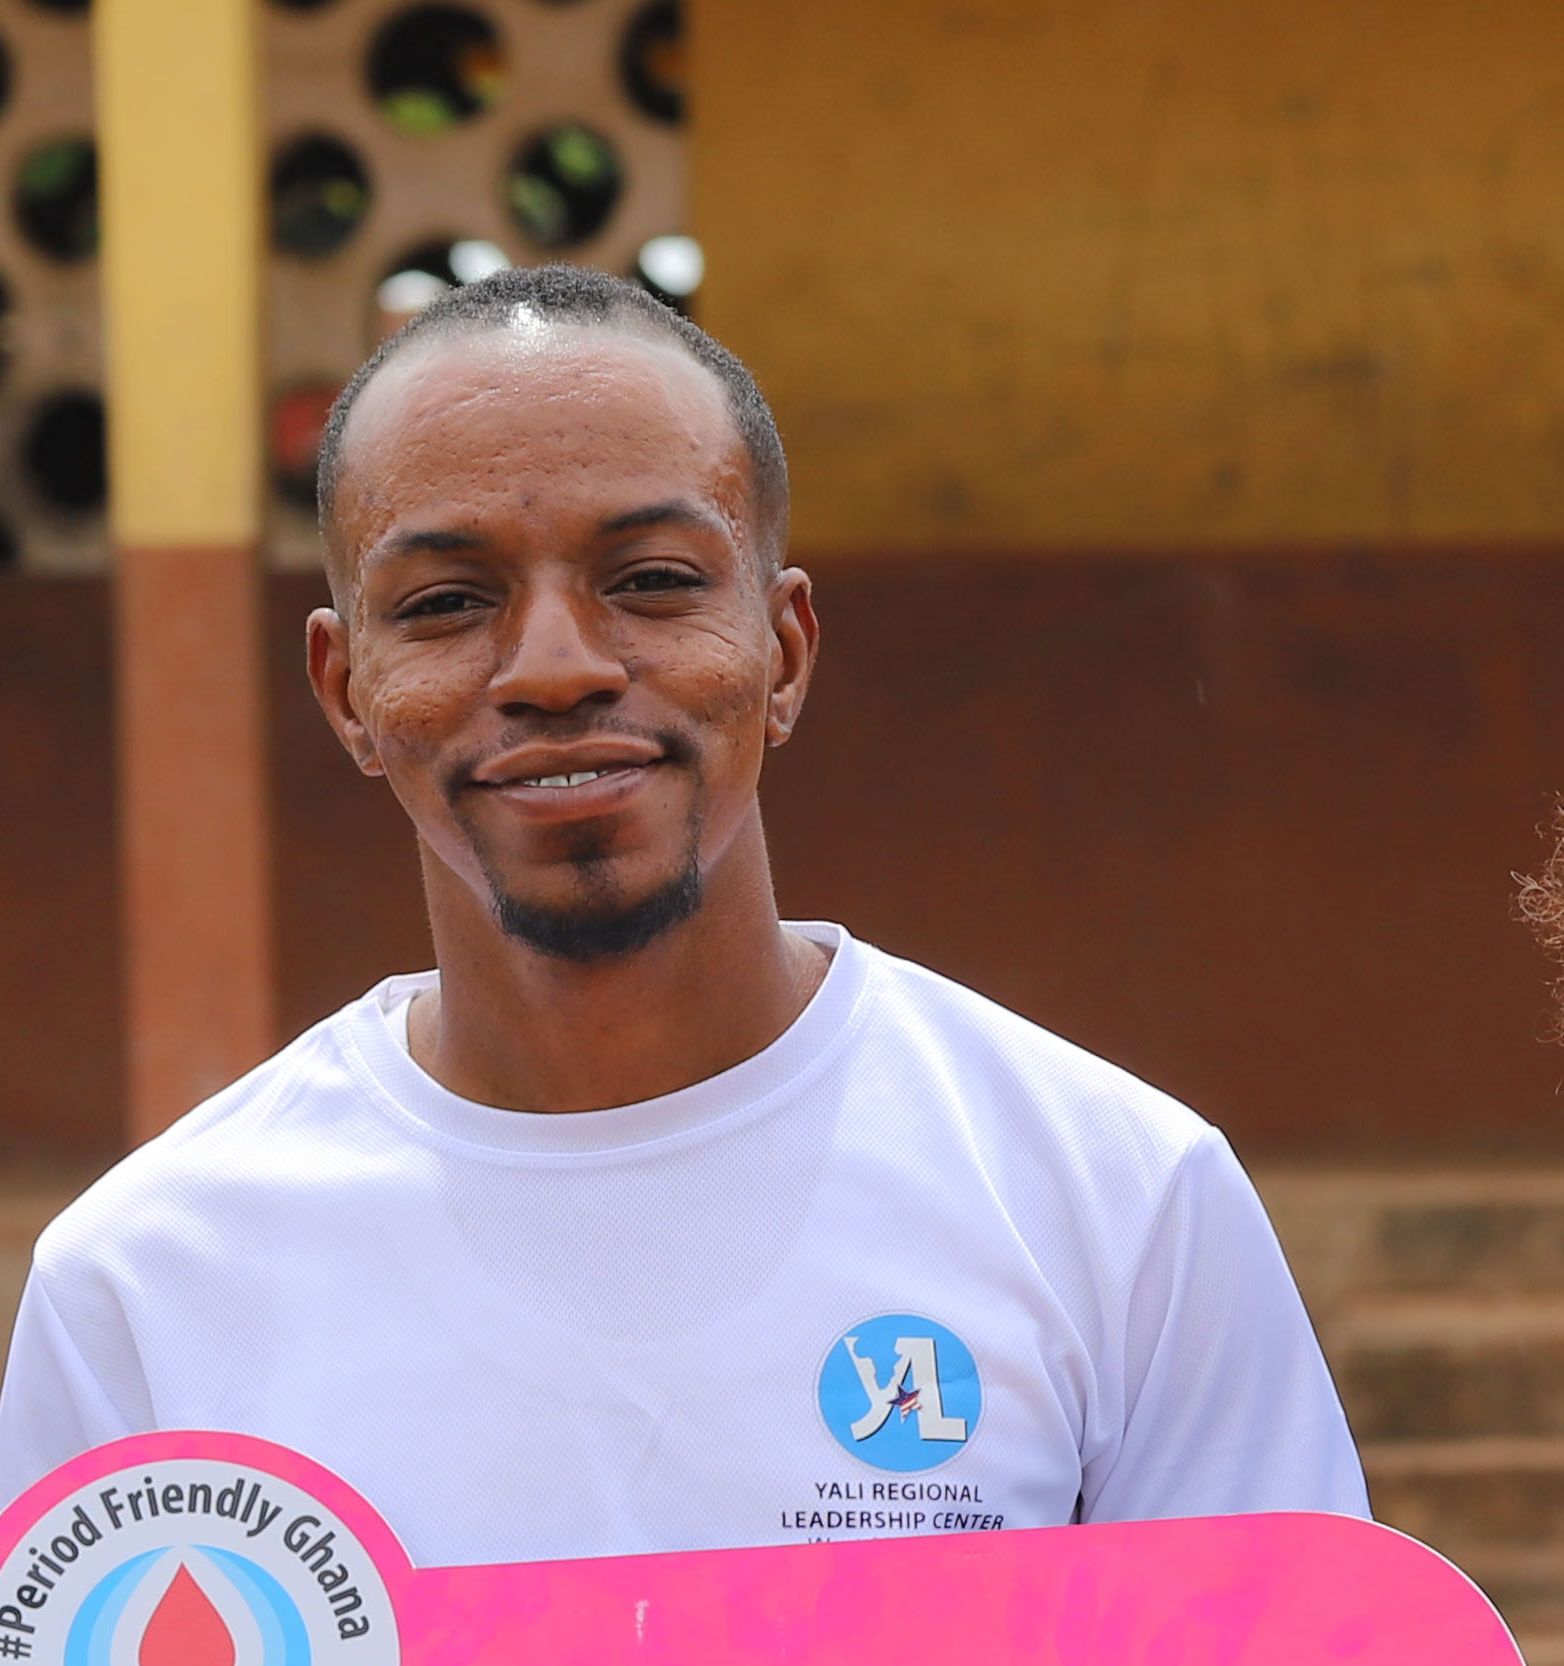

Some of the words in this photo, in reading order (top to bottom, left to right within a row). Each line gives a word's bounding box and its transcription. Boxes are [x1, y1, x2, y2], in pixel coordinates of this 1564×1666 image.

[815, 1482, 864, 1500] YALI
[873, 1482, 983, 1503] REGIONAL
[782, 1511, 926, 1529] LEADERSHIP
[933, 1512, 1005, 1531] CENTER
[99, 1475, 283, 1538] Friendly
[282, 1513, 371, 1641] Ghana
